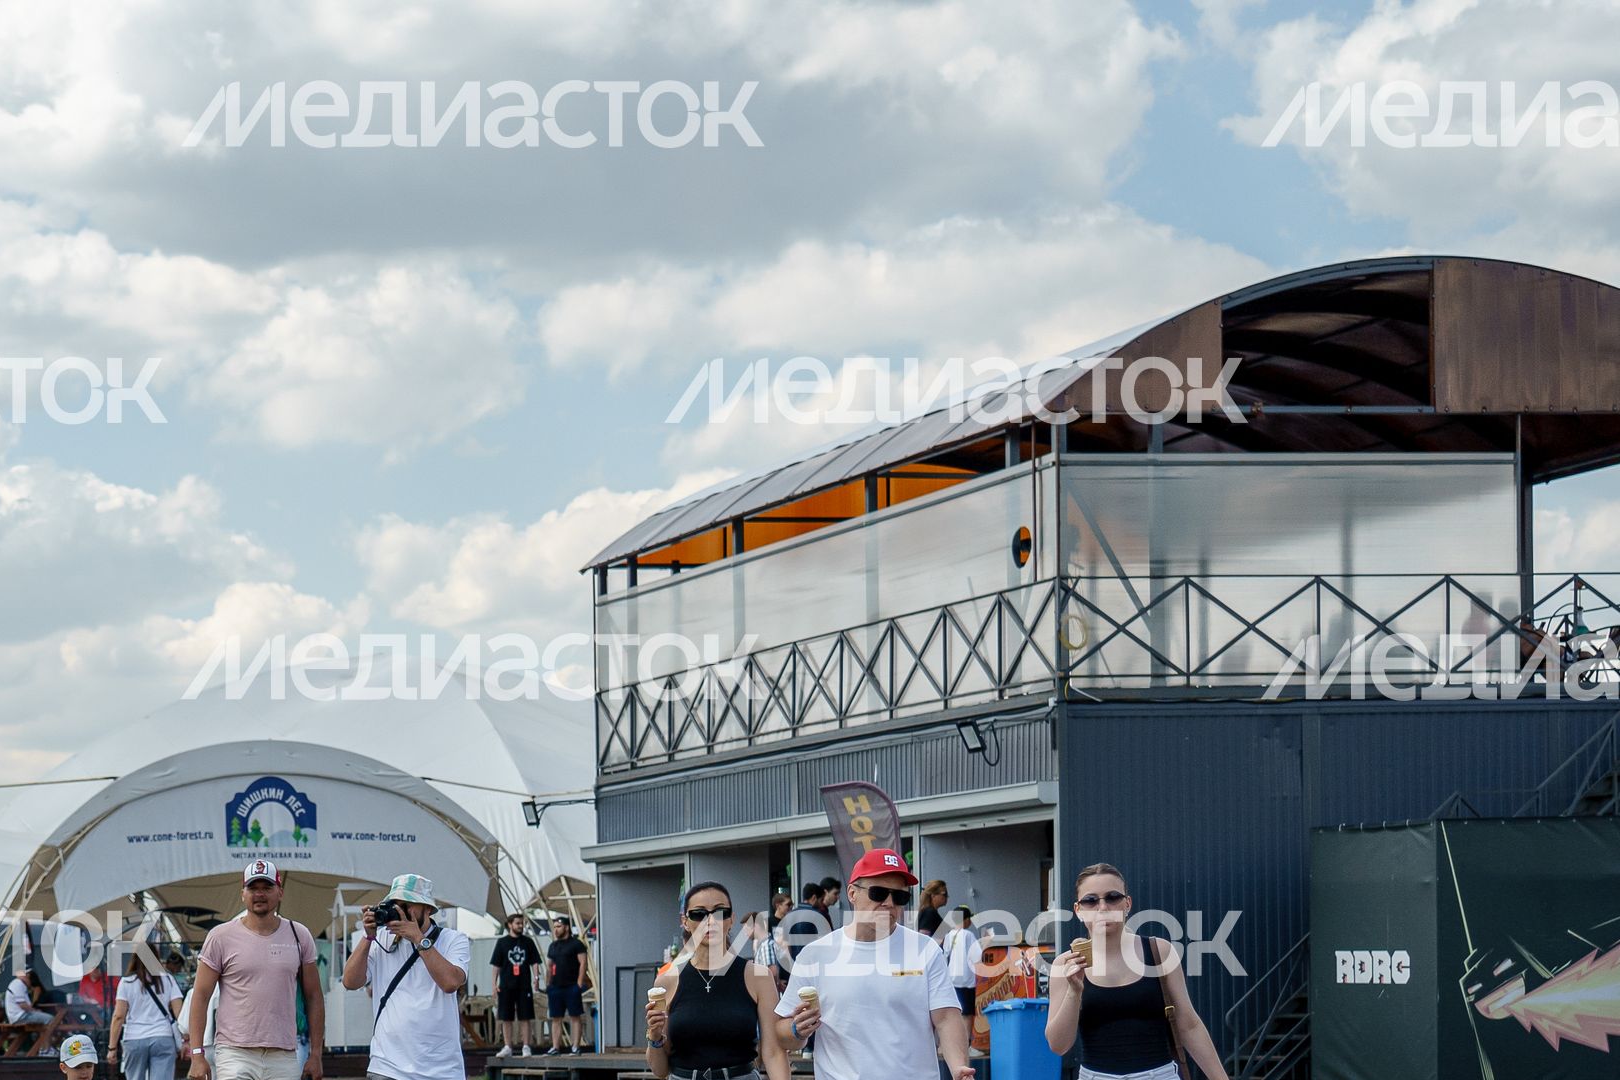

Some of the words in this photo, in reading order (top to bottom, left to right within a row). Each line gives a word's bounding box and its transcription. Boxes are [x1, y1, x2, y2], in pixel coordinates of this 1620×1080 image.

[237, 787, 284, 817] ШИШКИН
[285, 795, 306, 817] ЛЕС
[842, 795, 876, 852] HOT
[126, 831, 214, 843] www.cone-forest.ru
[330, 832, 416, 842] www.cone-forest.ru
